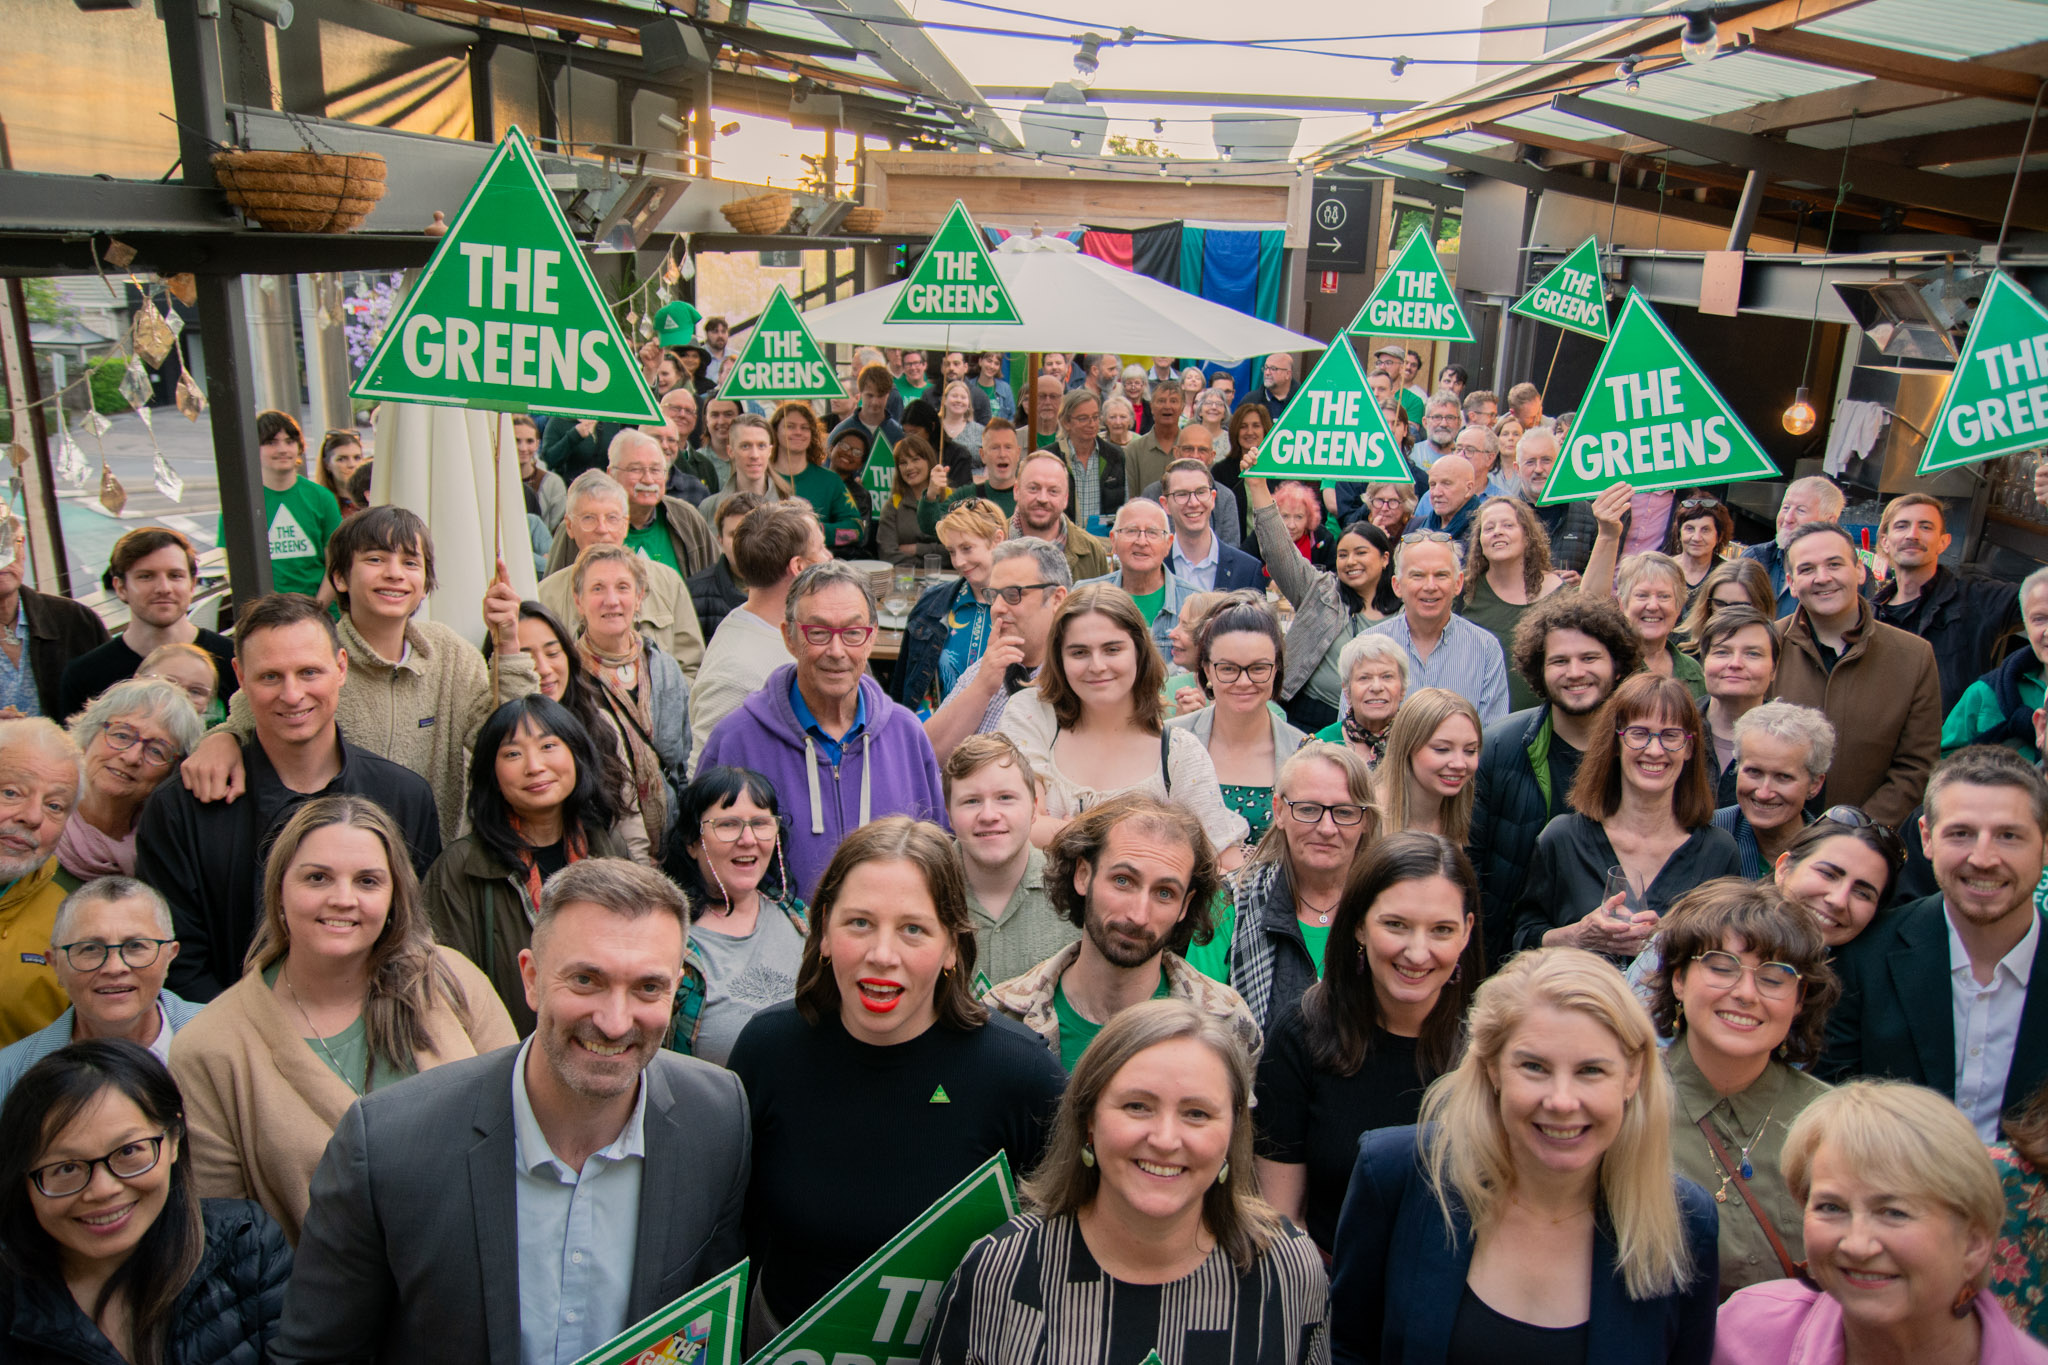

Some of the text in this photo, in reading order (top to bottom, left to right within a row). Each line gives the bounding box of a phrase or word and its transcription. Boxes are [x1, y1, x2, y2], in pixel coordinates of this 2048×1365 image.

[460, 241, 561, 315] THE
[933, 251, 977, 280] THE
[907, 283, 999, 314] GREENS
[1396, 270, 1437, 299] THE
[1560, 267, 1597, 298] THE
[1369, 299, 1455, 331] GREENS
[1532, 287, 1603, 327] GREENS
[402, 313, 611, 394] GREENS
[760, 330, 803, 359] THE
[738, 360, 826, 391] GREENS
[1307, 390, 1362, 426] THE
[1604, 366, 1685, 422] THE
[1948, 384, 2048, 447] GREE
[1270, 429, 1386, 468] GREENS
[1570, 414, 1731, 480] GREENS
[275, 526, 296, 539] THE
[666, 1335, 703, 1363] THE
